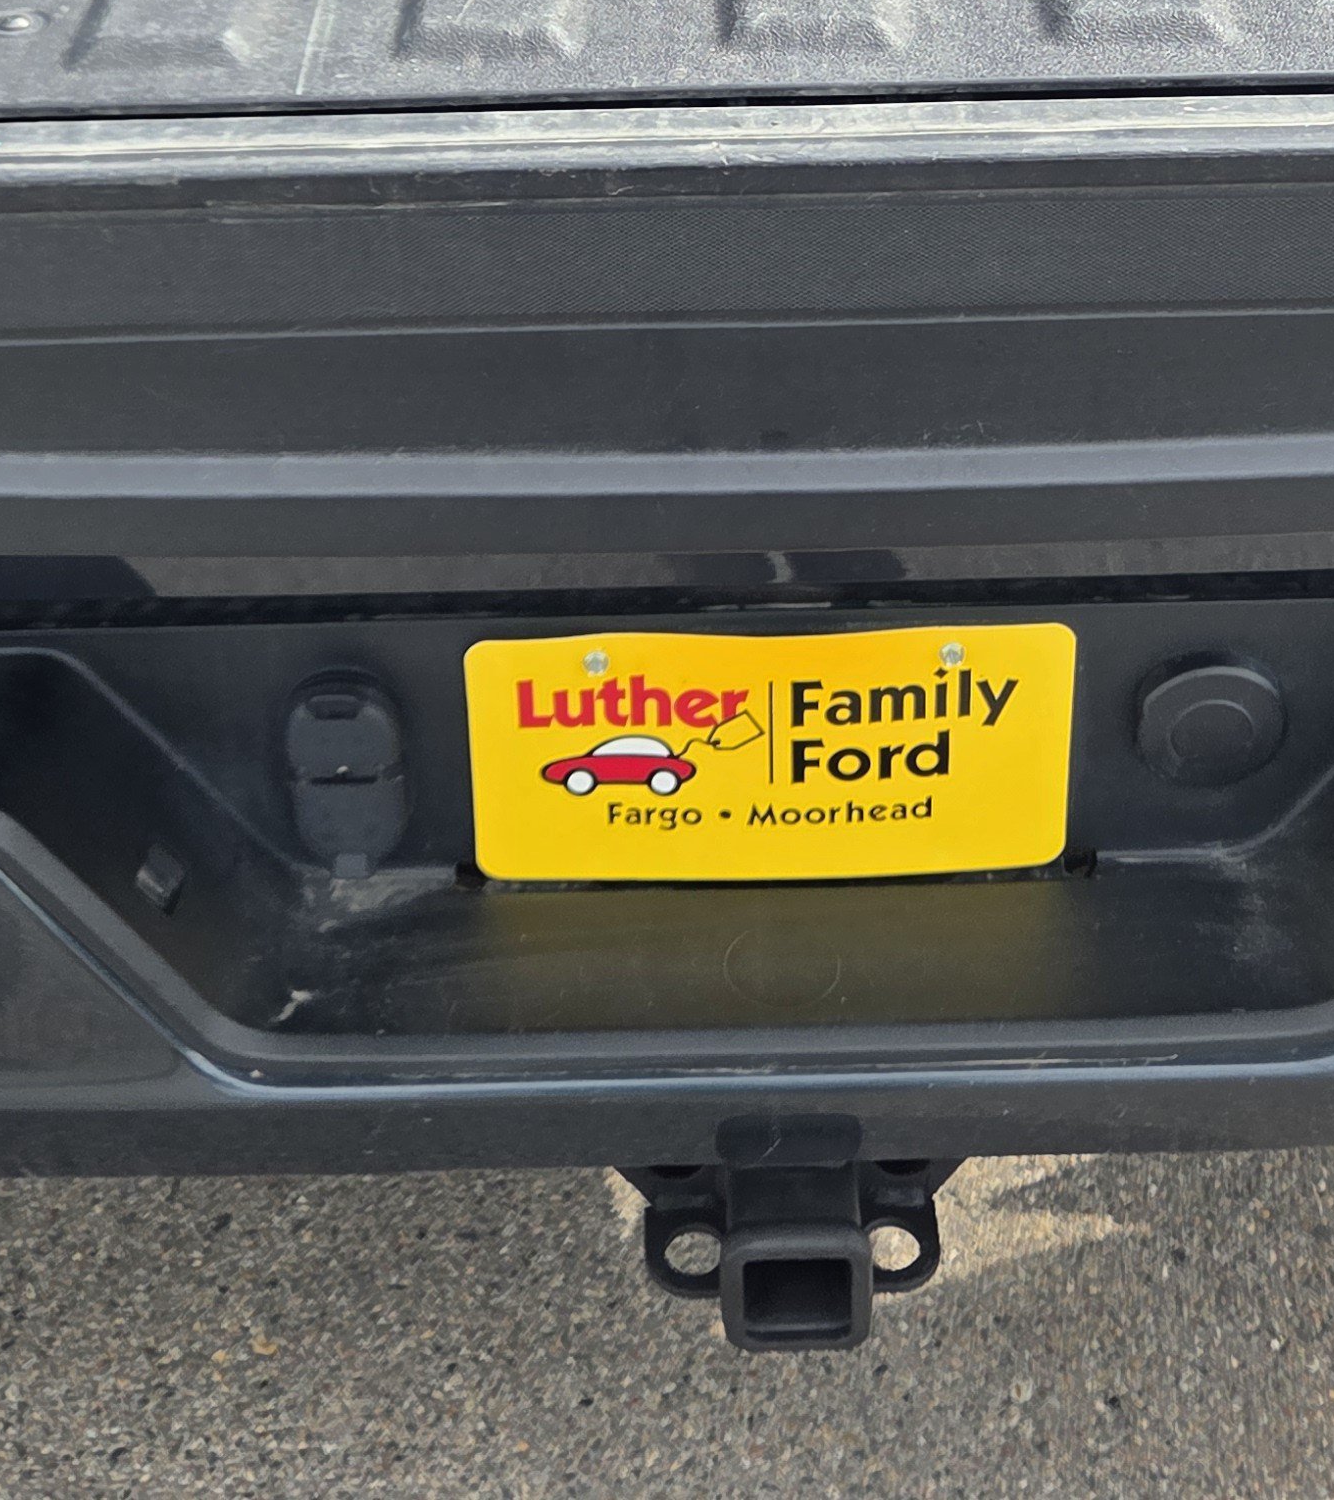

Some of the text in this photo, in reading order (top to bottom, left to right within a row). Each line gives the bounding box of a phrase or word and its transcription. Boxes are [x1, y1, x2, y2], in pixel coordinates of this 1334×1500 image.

[517, 668, 1019, 728] Luther Family
[790, 729, 951, 786] Ford
[607, 796, 933, 831] Fargo Moorhead
